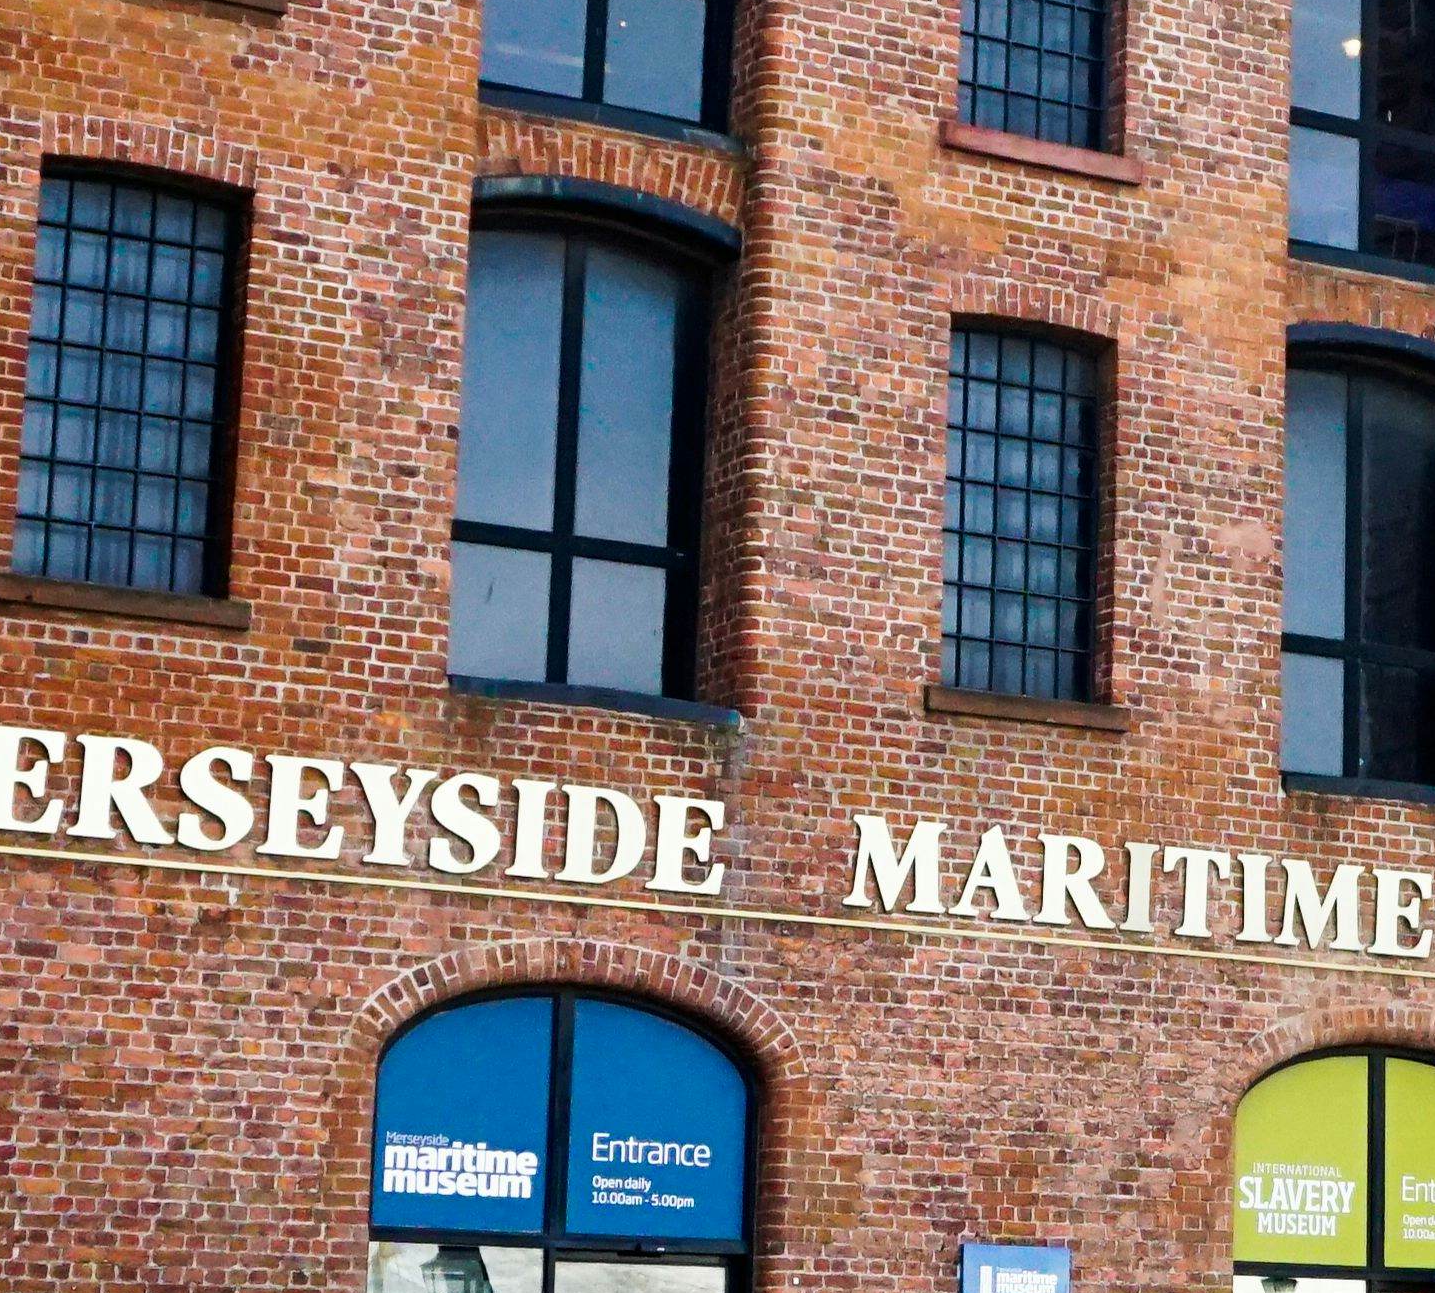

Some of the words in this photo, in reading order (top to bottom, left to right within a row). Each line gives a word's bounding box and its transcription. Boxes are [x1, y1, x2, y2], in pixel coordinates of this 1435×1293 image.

[841, 813, 1433, 959] MARITIME
[386, 1131, 449, 1147] Merseyside
[384, 1142, 538, 1175] maritime
[592, 1132, 711, 1168] Entrance
[1253, 1162, 1343, 1178] INTERNATIONAL
[382, 1168, 532, 1199] museum
[592, 1176, 622, 1191] Open
[624, 1176, 652, 1192] daily
[591, 1192, 643, 1207] 10.00am
[650, 1194, 695, 1209] 5.00pm
[1239, 1176, 1356, 1213] SLAVERY
[1257, 1212, 1336, 1236] MUSEUM
[1402, 1214, 1427, 1227] Open
[996, 1271, 1058, 1286] maritime
